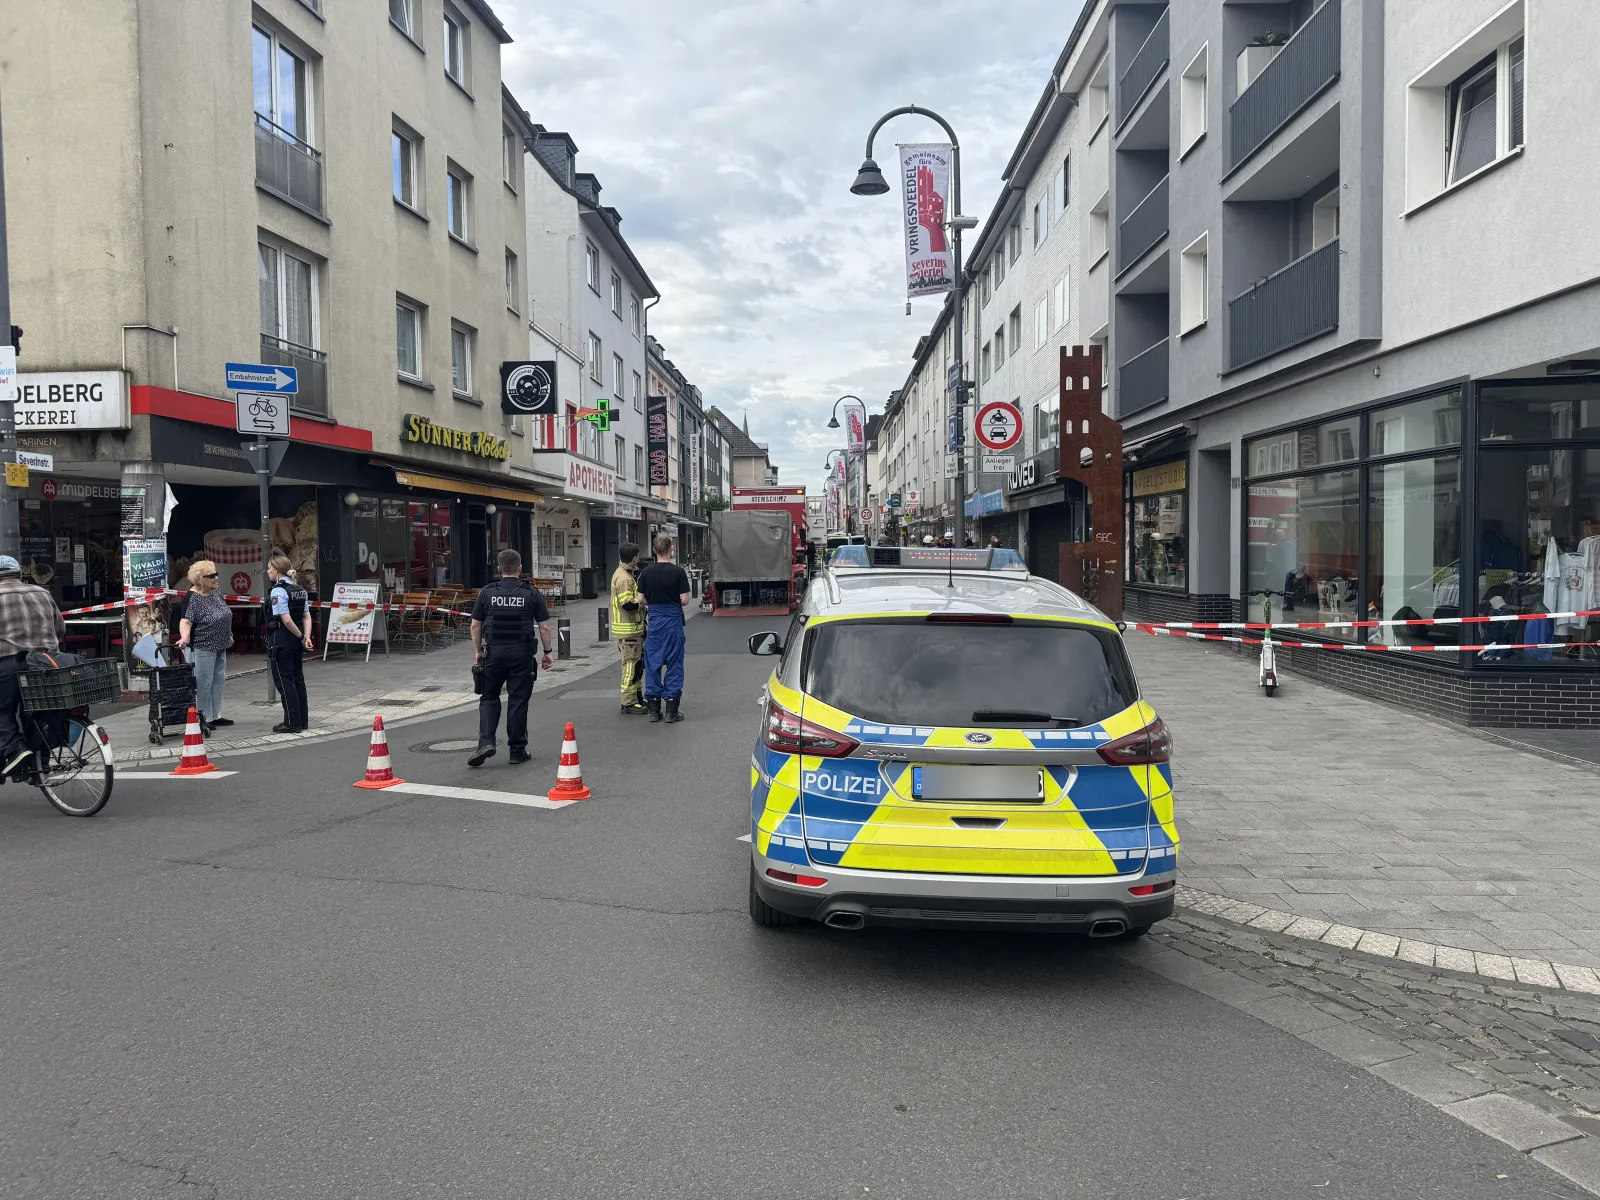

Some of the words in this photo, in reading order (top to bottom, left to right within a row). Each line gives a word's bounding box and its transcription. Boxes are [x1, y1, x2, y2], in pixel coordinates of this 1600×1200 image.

[904, 151, 946, 166] gemeinsam
[907, 166, 919, 256] VRINGSVEEDEL
[229, 373, 277, 382] Einbahnstraße
[650, 413, 666, 442] HAUS
[474, 431, 510, 461] Kölsch
[18, 454, 50, 468] Severinstr.
[651, 449, 667, 483] KEBAB
[985, 457, 1012, 465] Anlieger
[569, 461, 613, 496] APOTHEKE
[1134, 475, 1154, 490] NAGEL
[1160, 467, 1186, 486] STUDIO
[751, 495, 787, 503] ATEMSCHUTZ
[132, 558, 164, 570] VIVALDI
[491, 596, 525, 607] POLIZEI
[970, 733, 988, 742] Ford
[804, 773, 882, 795] POLIZEI
